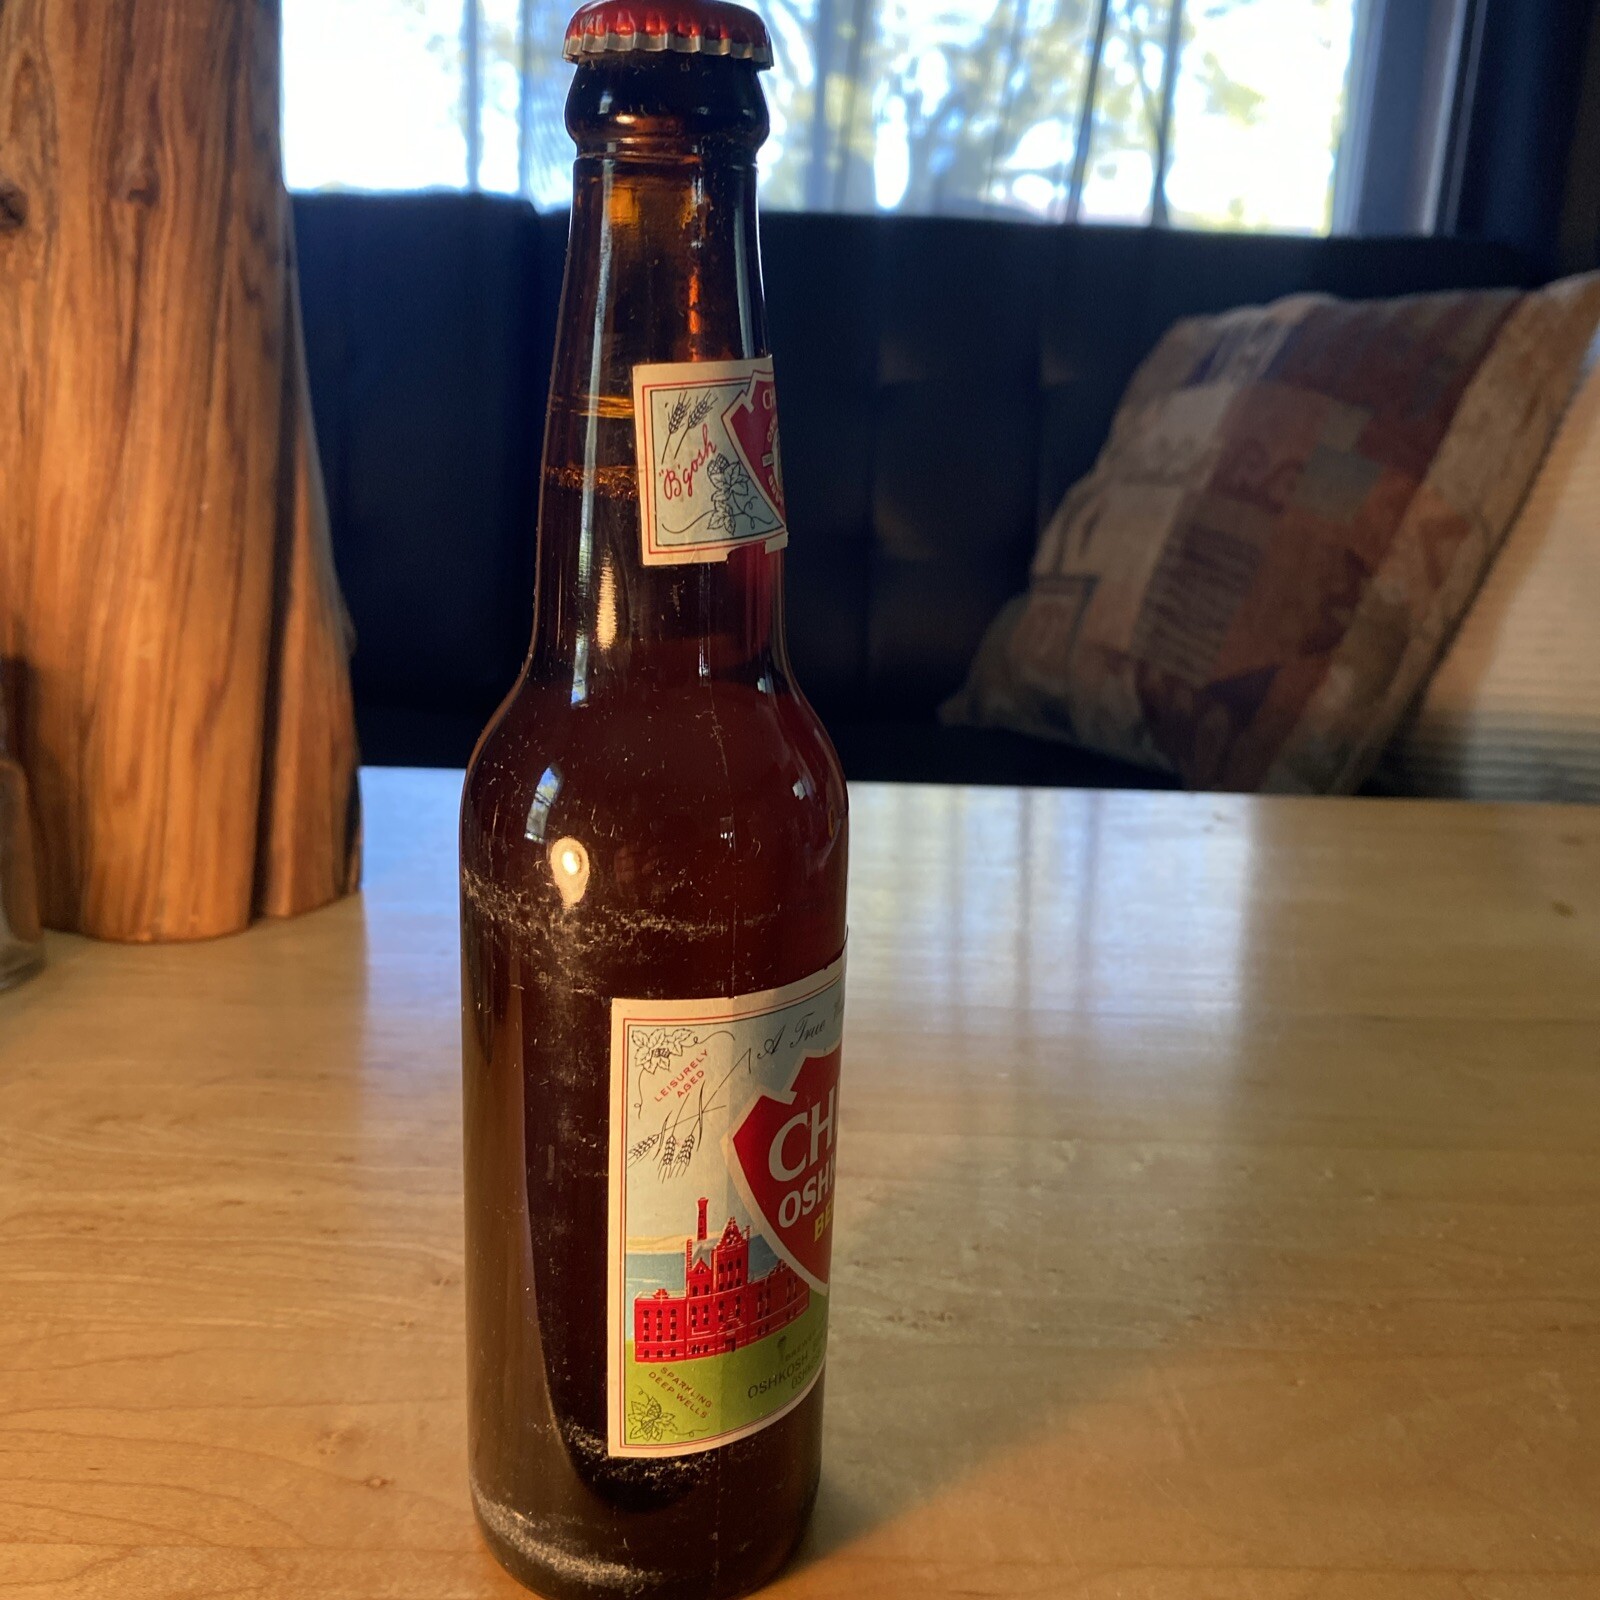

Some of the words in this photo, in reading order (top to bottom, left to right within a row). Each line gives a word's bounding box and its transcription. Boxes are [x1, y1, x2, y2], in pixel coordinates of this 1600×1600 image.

[757, 1024, 786, 1059] A
[790, 1011, 826, 1048] True
[654, 1049, 708, 1102] LEISURELY
[677, 1070, 705, 1098] AGED
[768, 1084, 838, 1182] CH
[648, 1371, 675, 1393] DEEP
[676, 1393, 708, 1419] WELLS
[660, 1366, 713, 1408] SPARKLING
[747, 1350, 808, 1399] OSHKOSH
